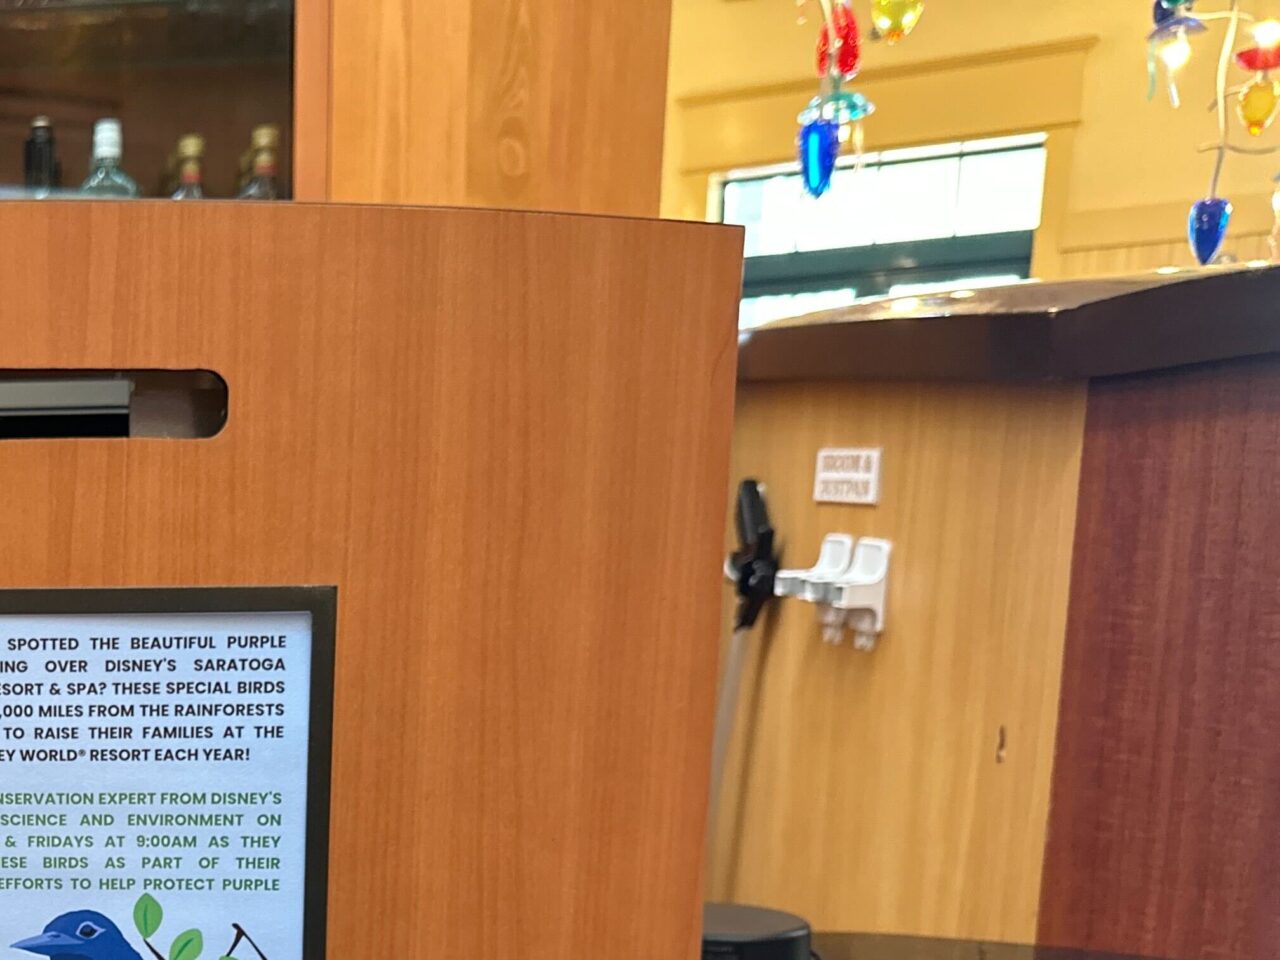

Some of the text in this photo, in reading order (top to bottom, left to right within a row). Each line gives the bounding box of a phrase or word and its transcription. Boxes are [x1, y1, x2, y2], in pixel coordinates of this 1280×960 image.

[7, 637, 80, 651] SPOTTED
[89, 637, 120, 650] THE
[130, 636, 217, 650] BEAUTIFUL
[227, 635, 287, 649] PURPLE
[44, 659, 88, 673] OVER
[105, 657, 177, 673] DISNEY'S
[193, 657, 286, 672] SARATOGA
[49, 682, 61, 696] &
[66, 681, 107, 696] SPA?
[111, 682, 161, 695] THESE
[166, 681, 232, 695] SPECIAL
[237, 680, 286, 694] BIRDS
[38, 705, 84, 718] MILES
[88, 704, 135, 718] FROM
[139, 704, 170, 717] THE
[174, 703, 285, 717] RAINFORESTS
[3, 727, 25, 740] TO
[34, 727, 79, 740] RAISE
[88, 726, 133, 740] THEIR
[142, 725, 214, 739] FAMILIES
[222, 725, 245, 739] AT
[253, 725, 285, 739] THE
[19, 749, 86, 762] WORLD®
[90, 748, 152, 762] RESORT
[154, 748, 199, 761] EACH
[202, 747, 250, 761] YEAR!
[98, 792, 157, 805] EXPERT
[160, 792, 207, 805] FROM
[211, 791, 283, 805] DISNEY'S
[0, 813, 67, 826] SCIENCE
[79, 813, 115, 826] AND
[127, 813, 245, 827] ENVIRONMENT
[256, 813, 283, 827] ON
[4, 835, 17, 848] &
[27, 835, 94, 848] FRIDAYS
[104, 835, 126, 848] AT
[136, 834, 198, 848] 9:00AM
[207, 835, 230, 848] AS
[240, 835, 282, 849] THEY
[42, 856, 89, 869] BIRDS
[104, 856, 126, 869] AS
[141, 856, 183, 870] PART
[198, 856, 220, 869] OF
[235, 856, 281, 870] THEIR
[70, 877, 92, 890] TO
[99, 878, 137, 890] HELP
[143, 878, 216, 891] PROTECT
[222, 878, 280, 891] PURPLE
